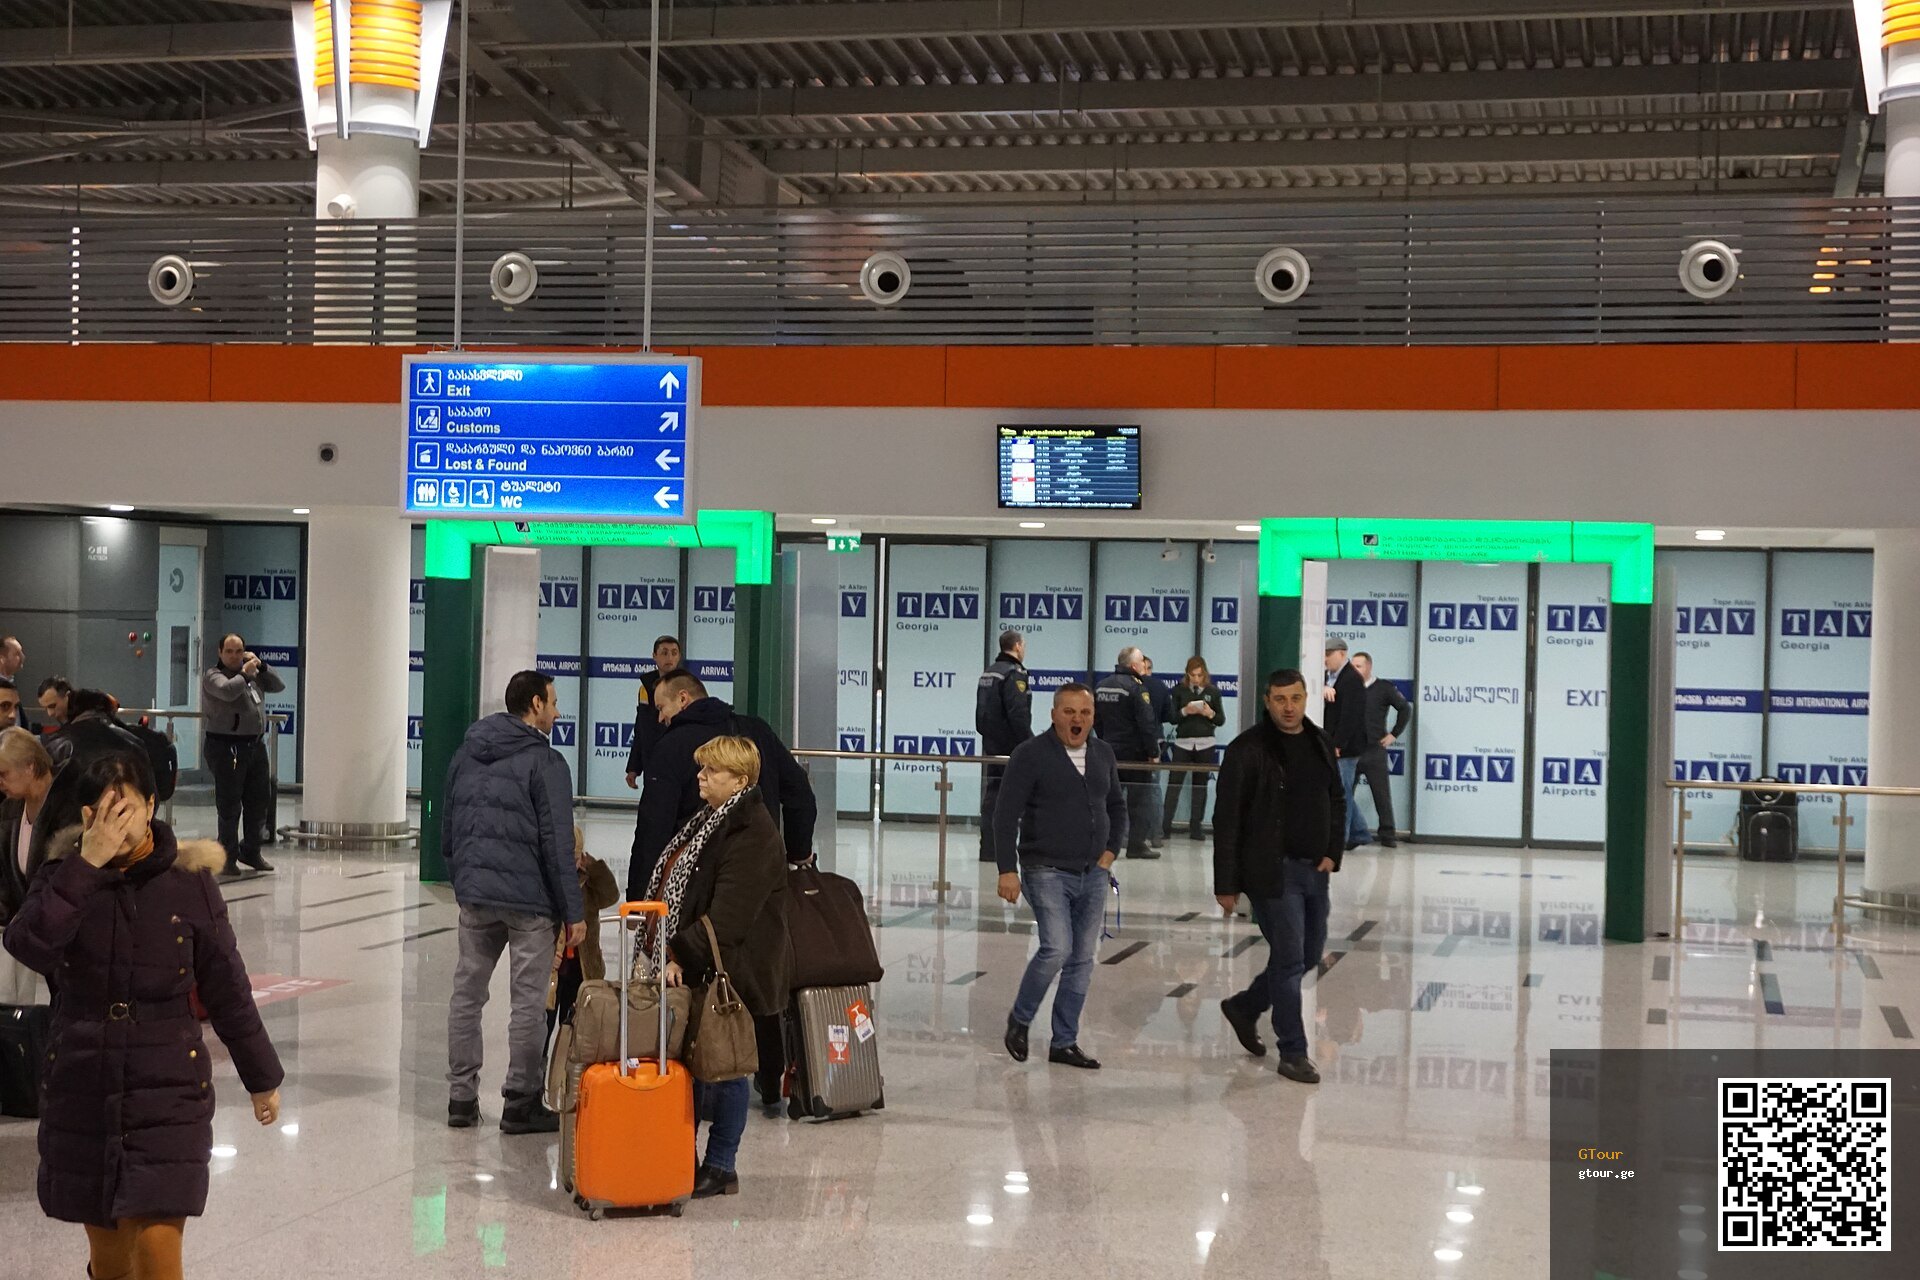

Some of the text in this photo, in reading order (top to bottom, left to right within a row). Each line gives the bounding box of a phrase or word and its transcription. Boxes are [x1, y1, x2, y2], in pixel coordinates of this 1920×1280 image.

[447, 369, 523, 381] გასასვლელი
[447, 384, 471, 396] Exit
[447, 405, 491, 417] საბაჟო
[446, 421, 501, 433] Customs
[445, 442, 634, 457] დაკარგული და ნაპოვნი ბარგი
[445, 458, 527, 471] Lost & Found
[501, 480, 561, 492] ტუალეტი
[500, 495, 523, 508] WC
[227, 577, 294, 598] TAV
[601, 586, 672, 608] TAV
[224, 602, 262, 611] Georgia
[900, 595, 976, 617] TAV
[1003, 595, 1080, 618] TAV
[1108, 597, 1187, 620] TAV
[597, 612, 639, 622] Georgia
[1327, 602, 1406, 624] TAV
[1431, 605, 1516, 629] TAV
[896, 621, 939, 632] Georgia
[1784, 611, 1871, 635] TAV
[1104, 624, 1149, 635] Georgia
[1428, 633, 1475, 644] Georgia
[1546, 635, 1594, 646] Georgia
[1781, 640, 1830, 652] Georgia
[700, 666, 729, 676] ARRIVAL
[913, 672, 956, 688] EXIT
[1423, 685, 1520, 705] გასასვლელი
[1772, 695, 1794, 706] TBILISI
[1797, 696, 1850, 708] INTERNATIONAL
[897, 737, 973, 755] TAV
[893, 761, 942, 773] Airports
[1428, 756, 1512, 780] TAV
[1424, 782, 1478, 793] Airports
[1542, 785, 1597, 797] Airports
